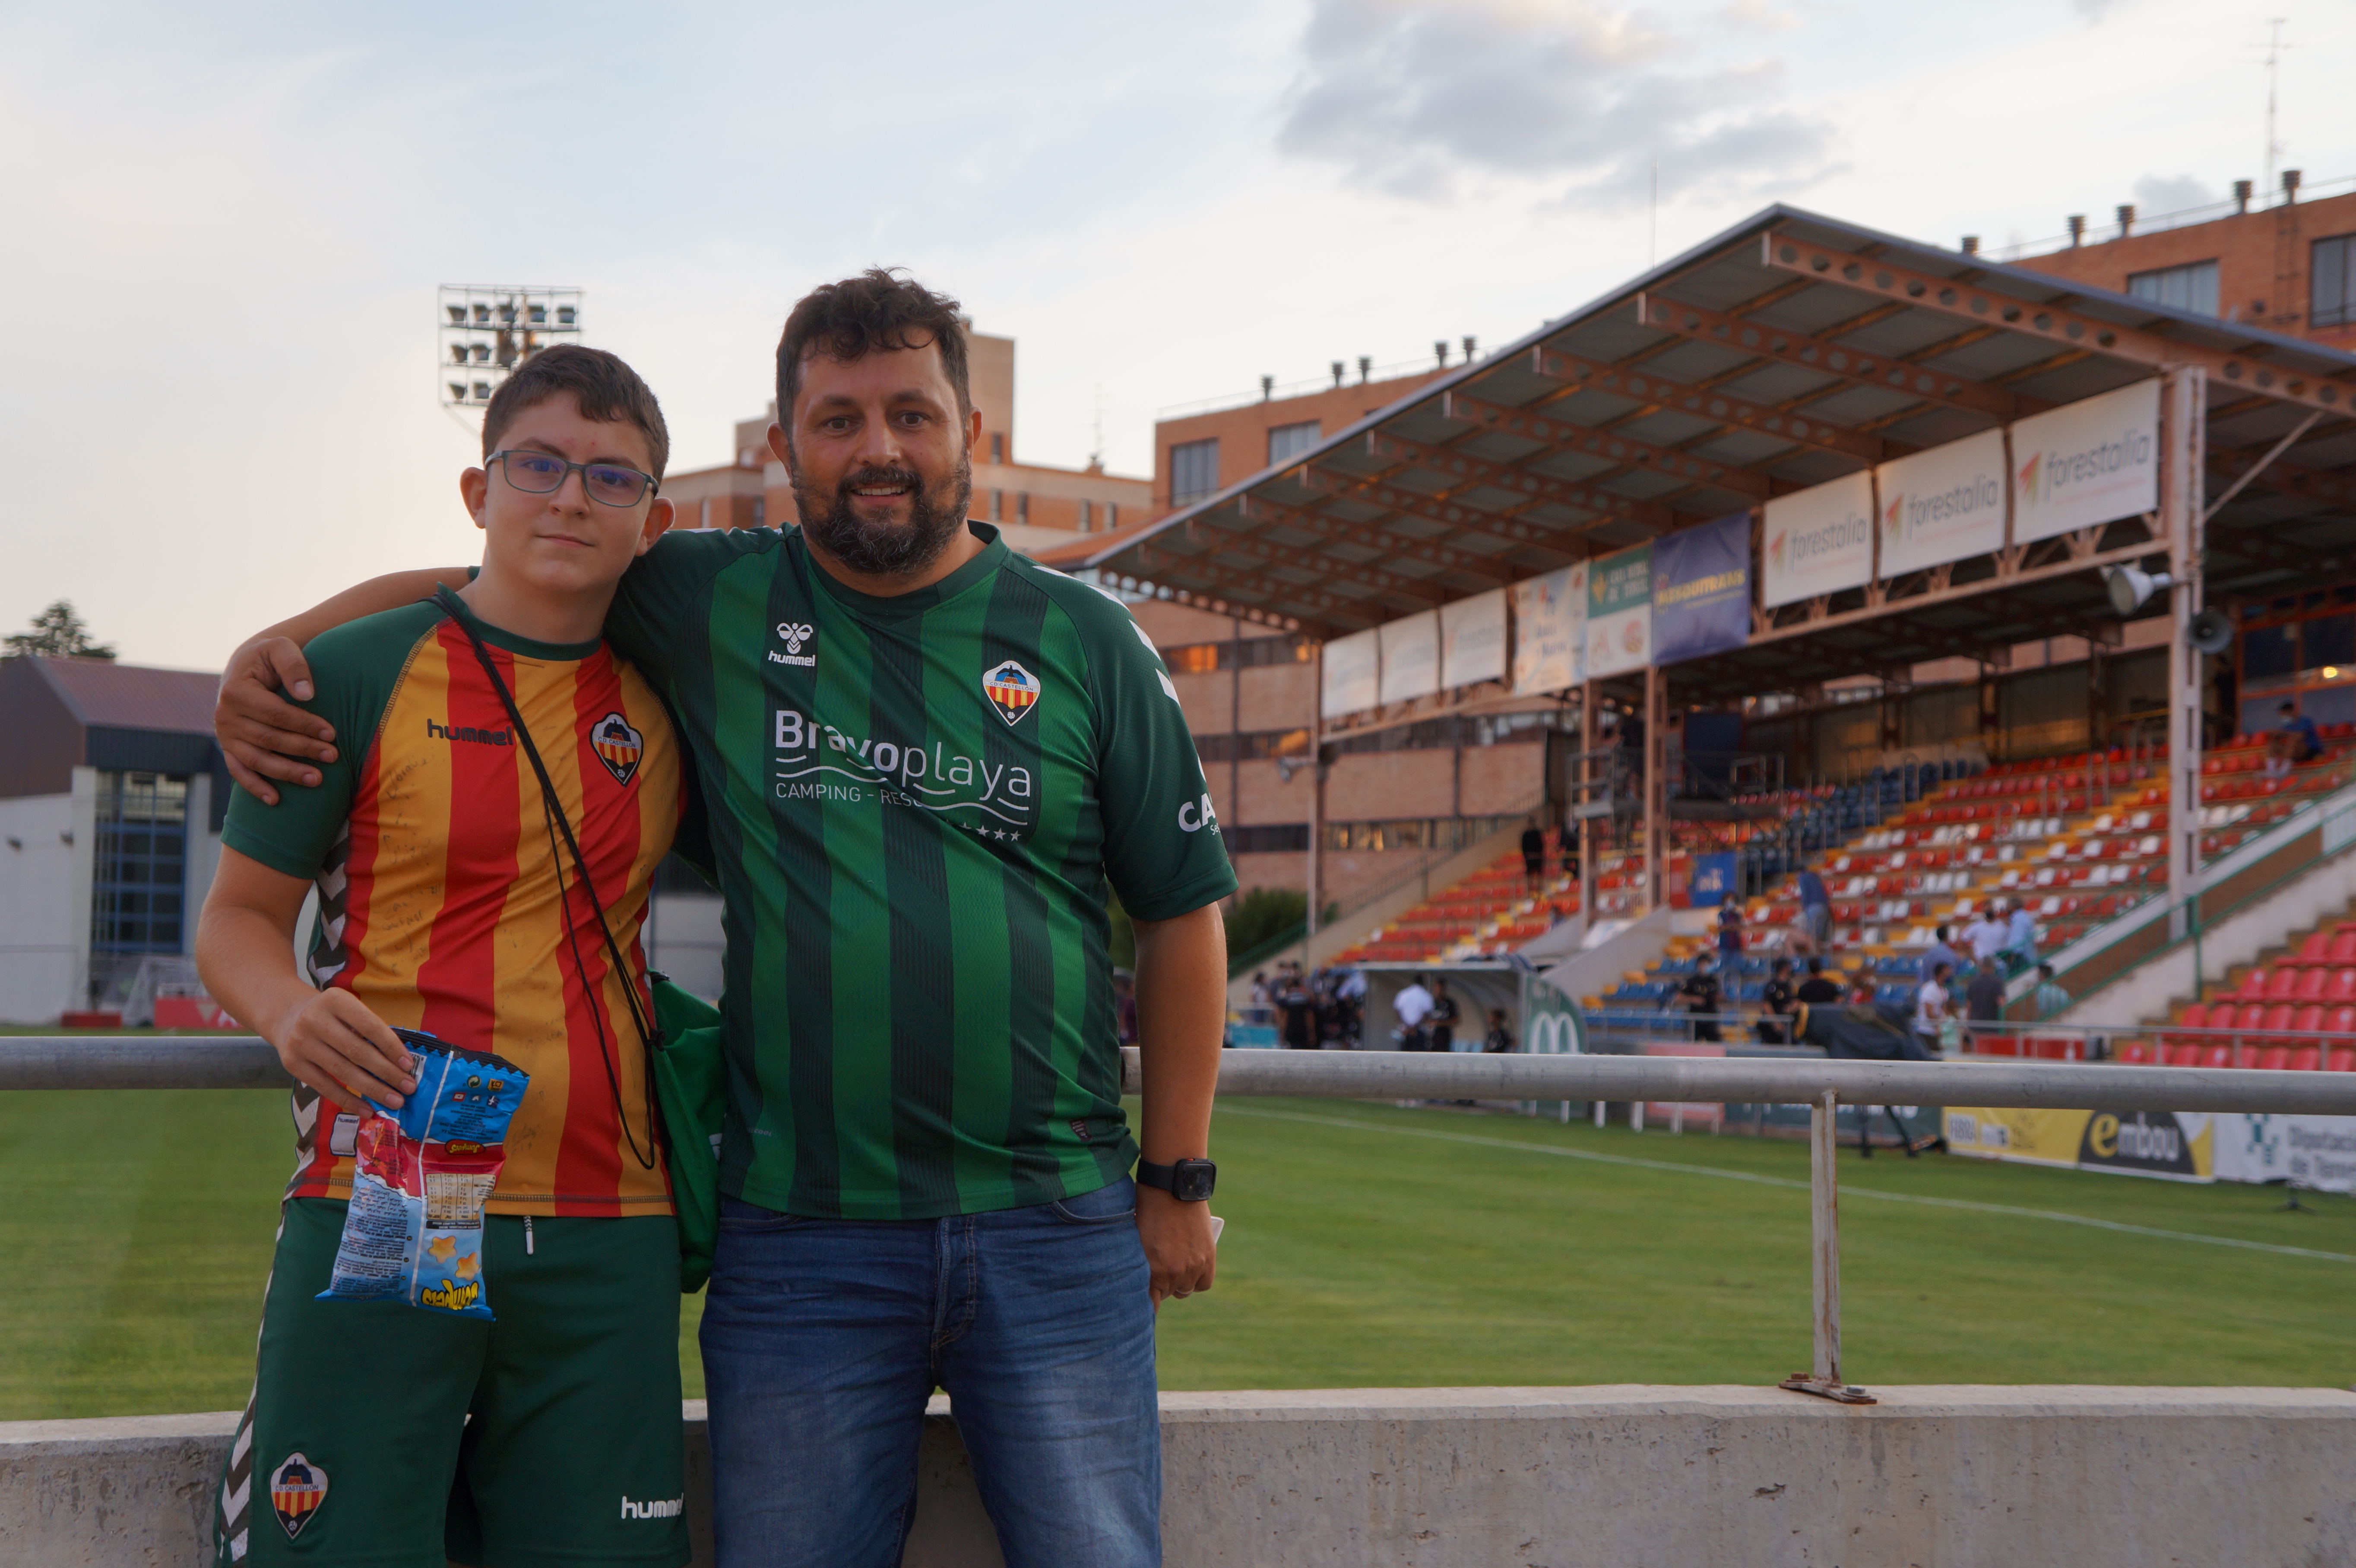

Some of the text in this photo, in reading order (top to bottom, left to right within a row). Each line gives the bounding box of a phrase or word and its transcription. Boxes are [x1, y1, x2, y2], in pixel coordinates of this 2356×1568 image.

[2046, 429, 2150, 502] forestalia
[1907, 474, 1998, 541] forestalia
[1790, 512, 1868, 571] forestalia
[768, 650, 815, 667] hummel
[427, 718, 513, 745] hummel
[776, 710, 1030, 800] Bravoplaya
[776, 783, 861, 802] CAMPING
[2089, 1113, 2180, 1161] embou
